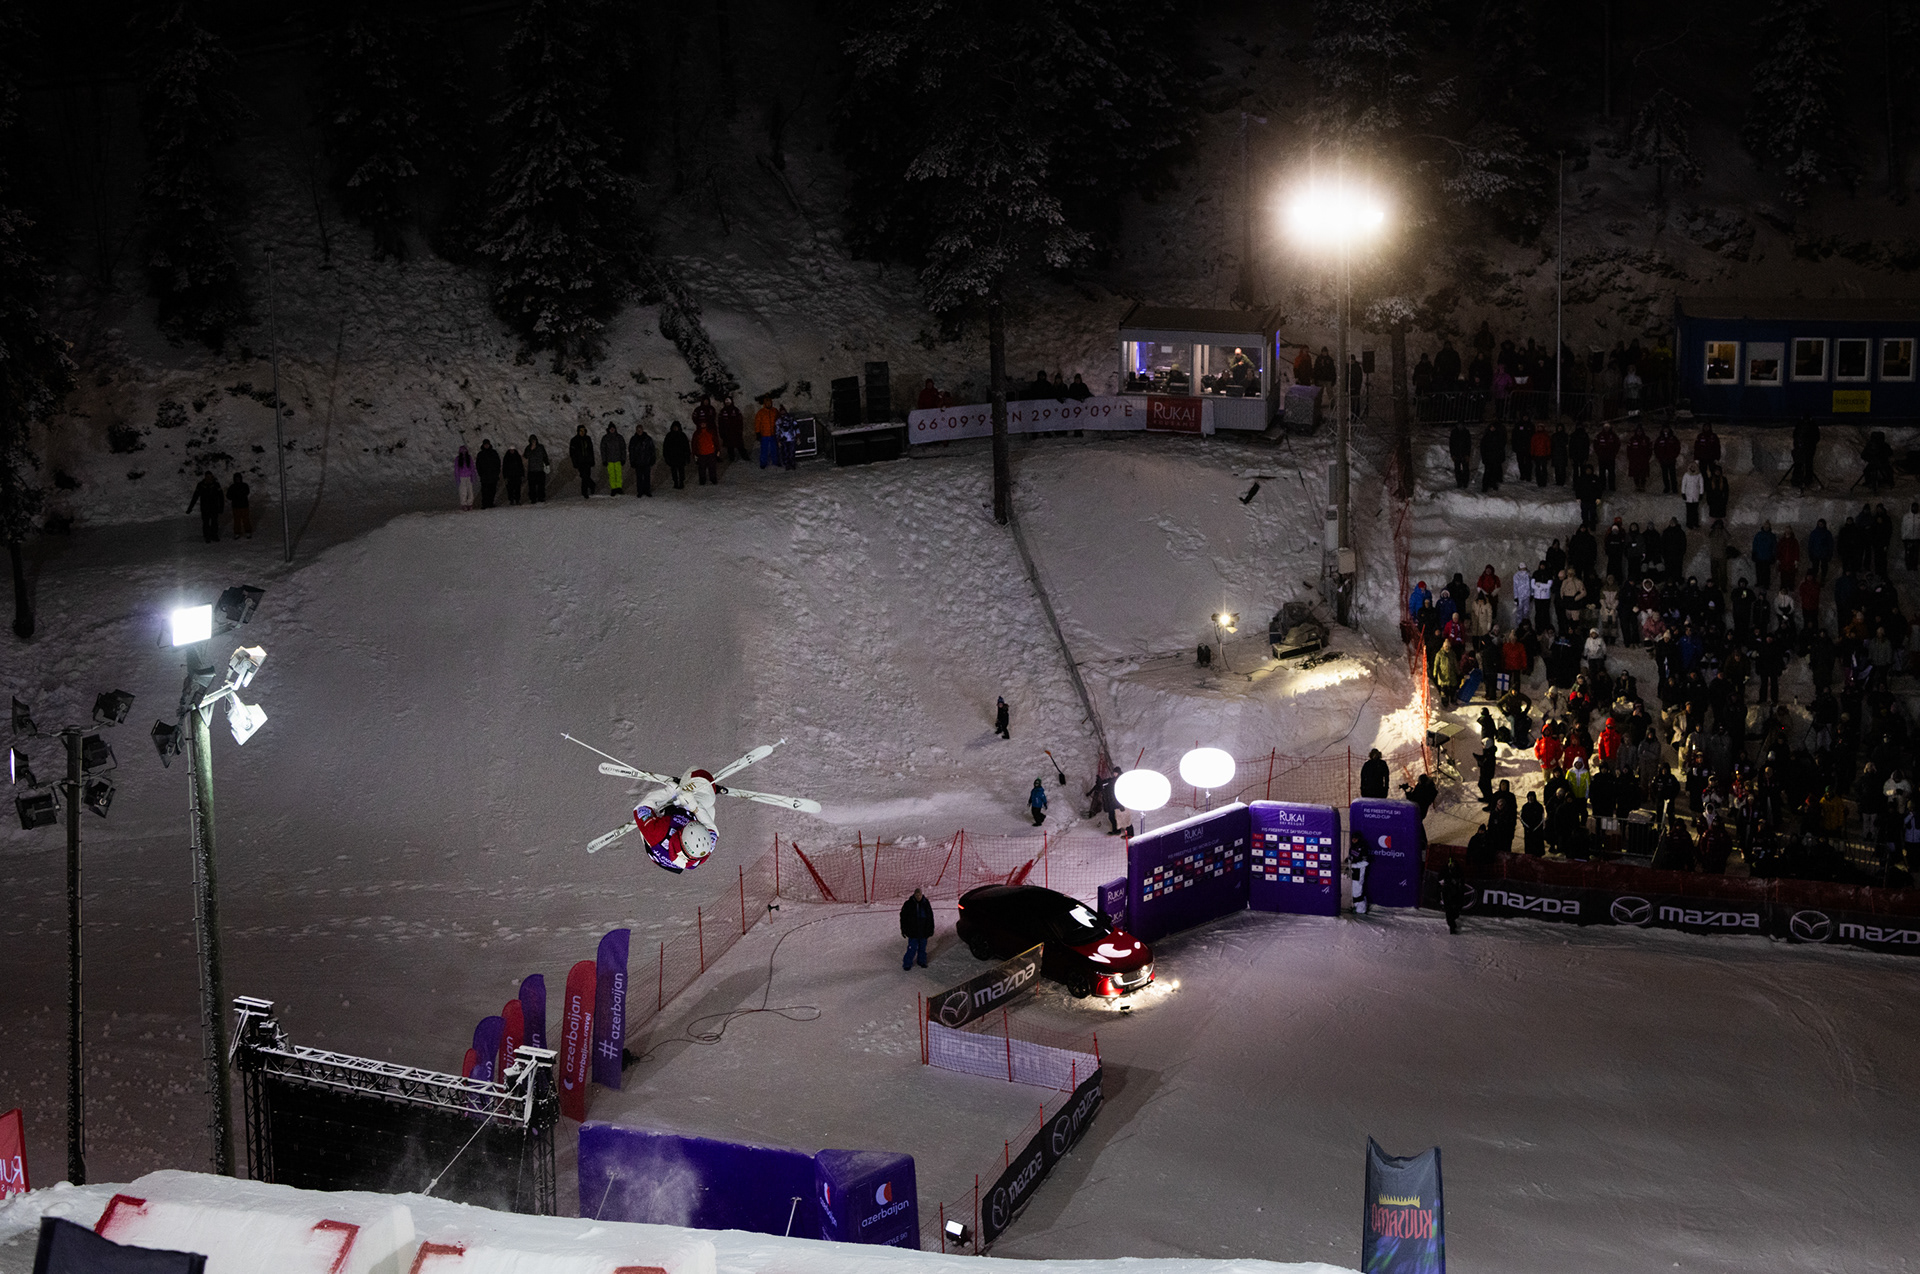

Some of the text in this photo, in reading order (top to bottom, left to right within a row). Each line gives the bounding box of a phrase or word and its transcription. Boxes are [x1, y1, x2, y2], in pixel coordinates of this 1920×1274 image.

[1153, 401, 1195, 421] RUKA!
[1279, 810, 1304, 822] RUKA!
[1184, 826, 1204, 841] RUKA!
[1482, 889, 1580, 915] mazda
[1659, 905, 1760, 929] mazda
[1838, 923, 1920, 945] mazd
[974, 961, 1036, 1009] mazda
[566, 995, 582, 1073] azerbaijan
[1008, 1151, 1043, 1205] mazda
[861, 1199, 910, 1228] azerbaijan
